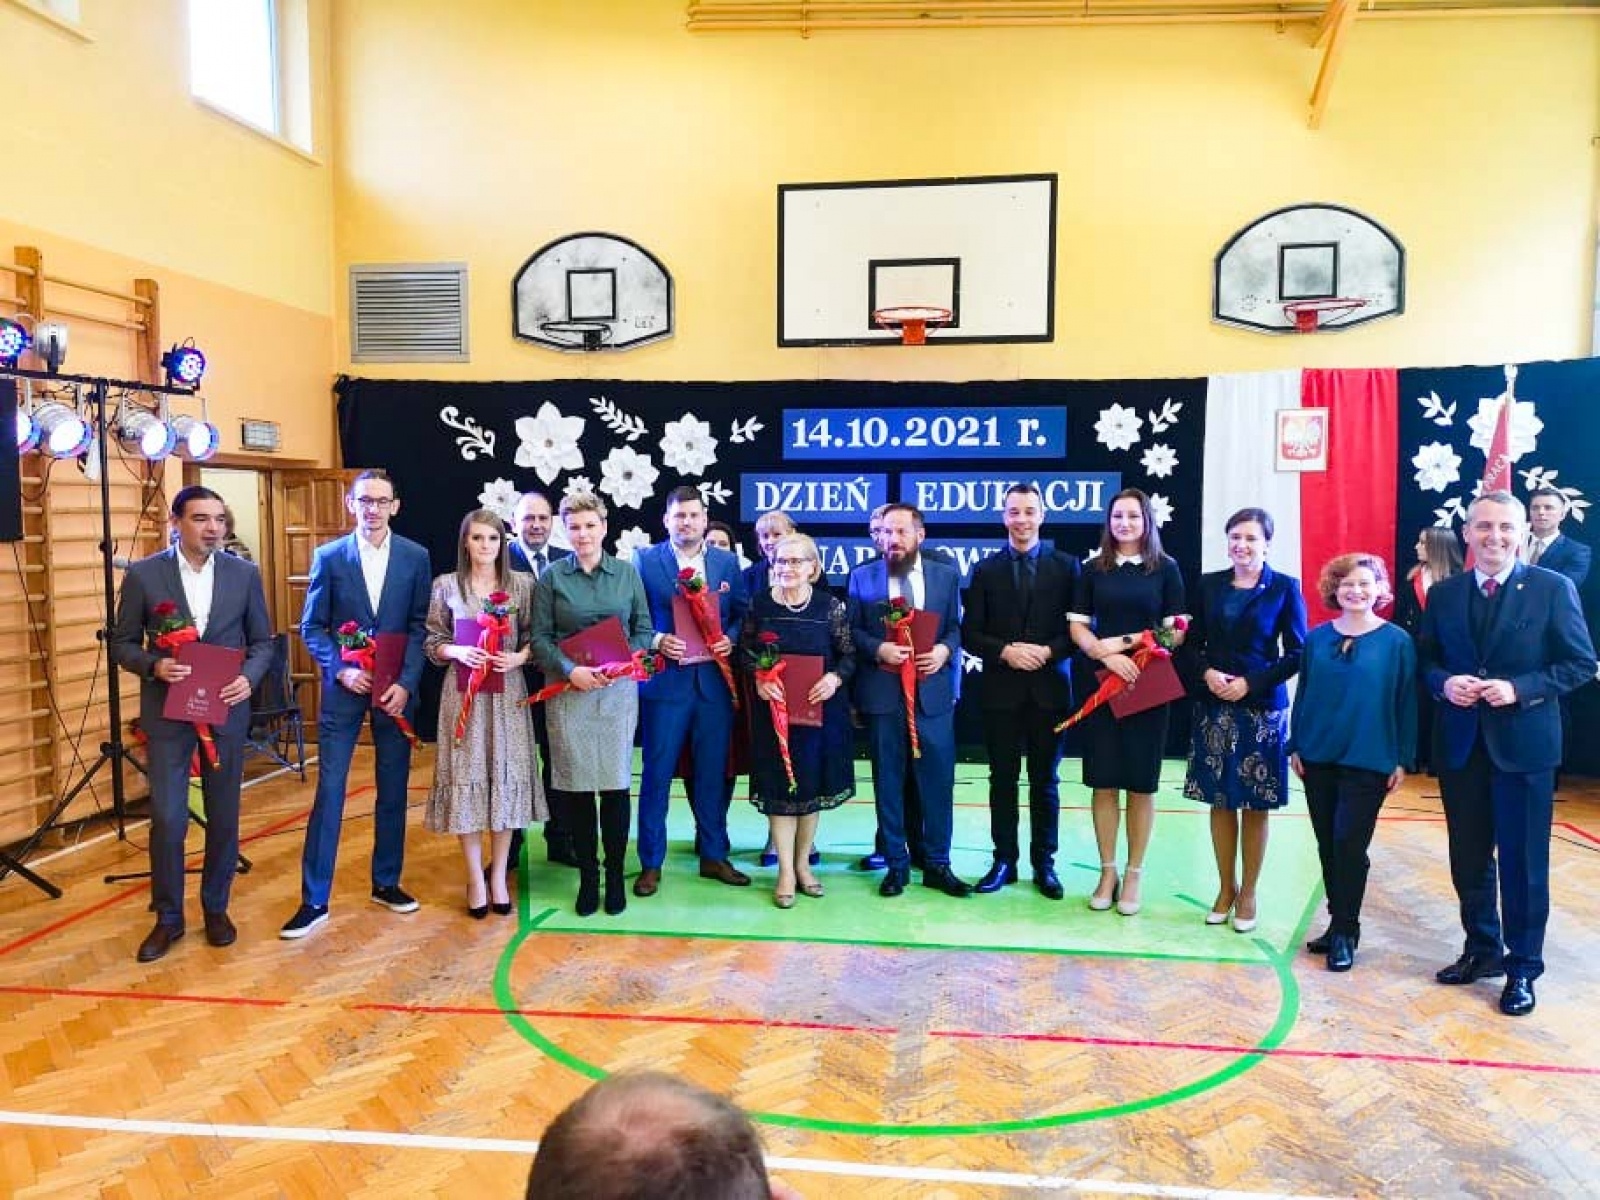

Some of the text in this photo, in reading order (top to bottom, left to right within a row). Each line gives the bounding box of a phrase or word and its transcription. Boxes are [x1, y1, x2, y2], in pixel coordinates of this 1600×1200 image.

[792, 416, 1047, 448] 14.10.2021 r.
[755, 476, 871, 512] DZIEŃ
